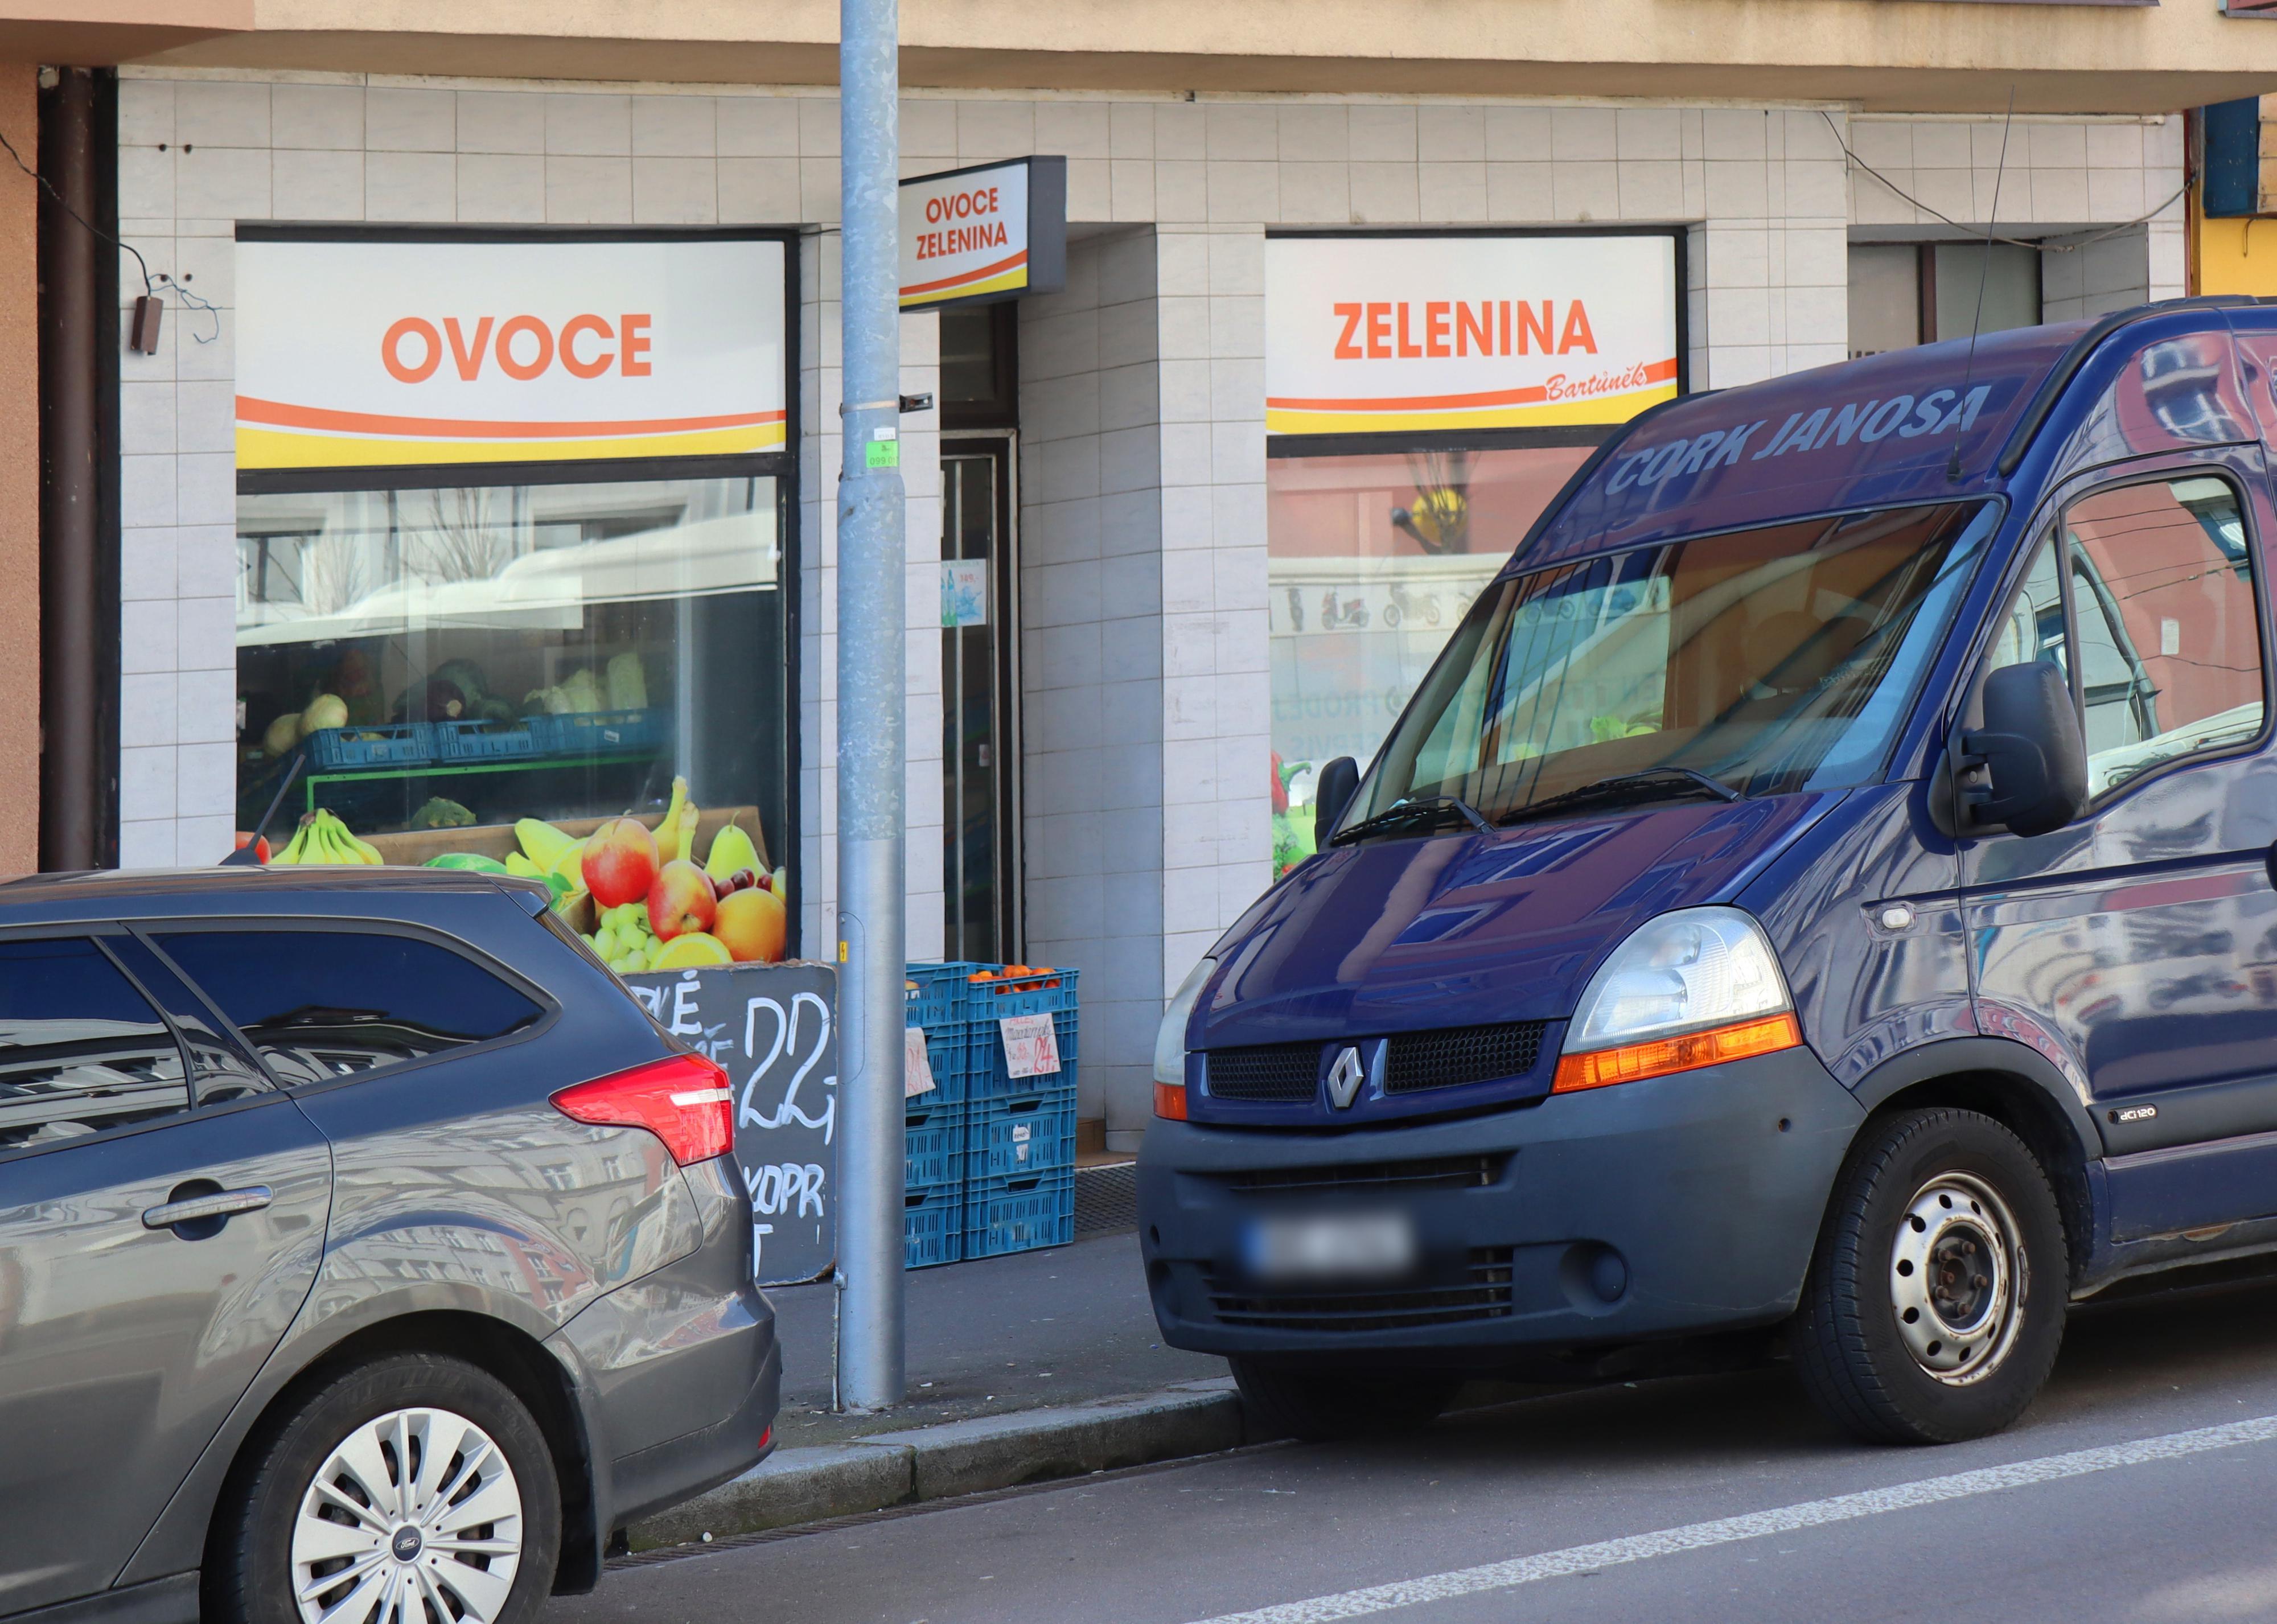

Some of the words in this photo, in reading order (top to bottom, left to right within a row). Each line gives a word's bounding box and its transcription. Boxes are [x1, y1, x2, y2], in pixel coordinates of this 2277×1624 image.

[926, 187, 998, 224] OVOCE
[916, 220, 1008, 261] ZELENINA
[381, 314, 652, 384] OVOCE
[1333, 299, 1598, 360] ZELENINA
[1546, 361, 1647, 401] Bartůněk
[1605, 420, 1768, 495] CORK
[1752, 385, 1992, 461] JANOSA
